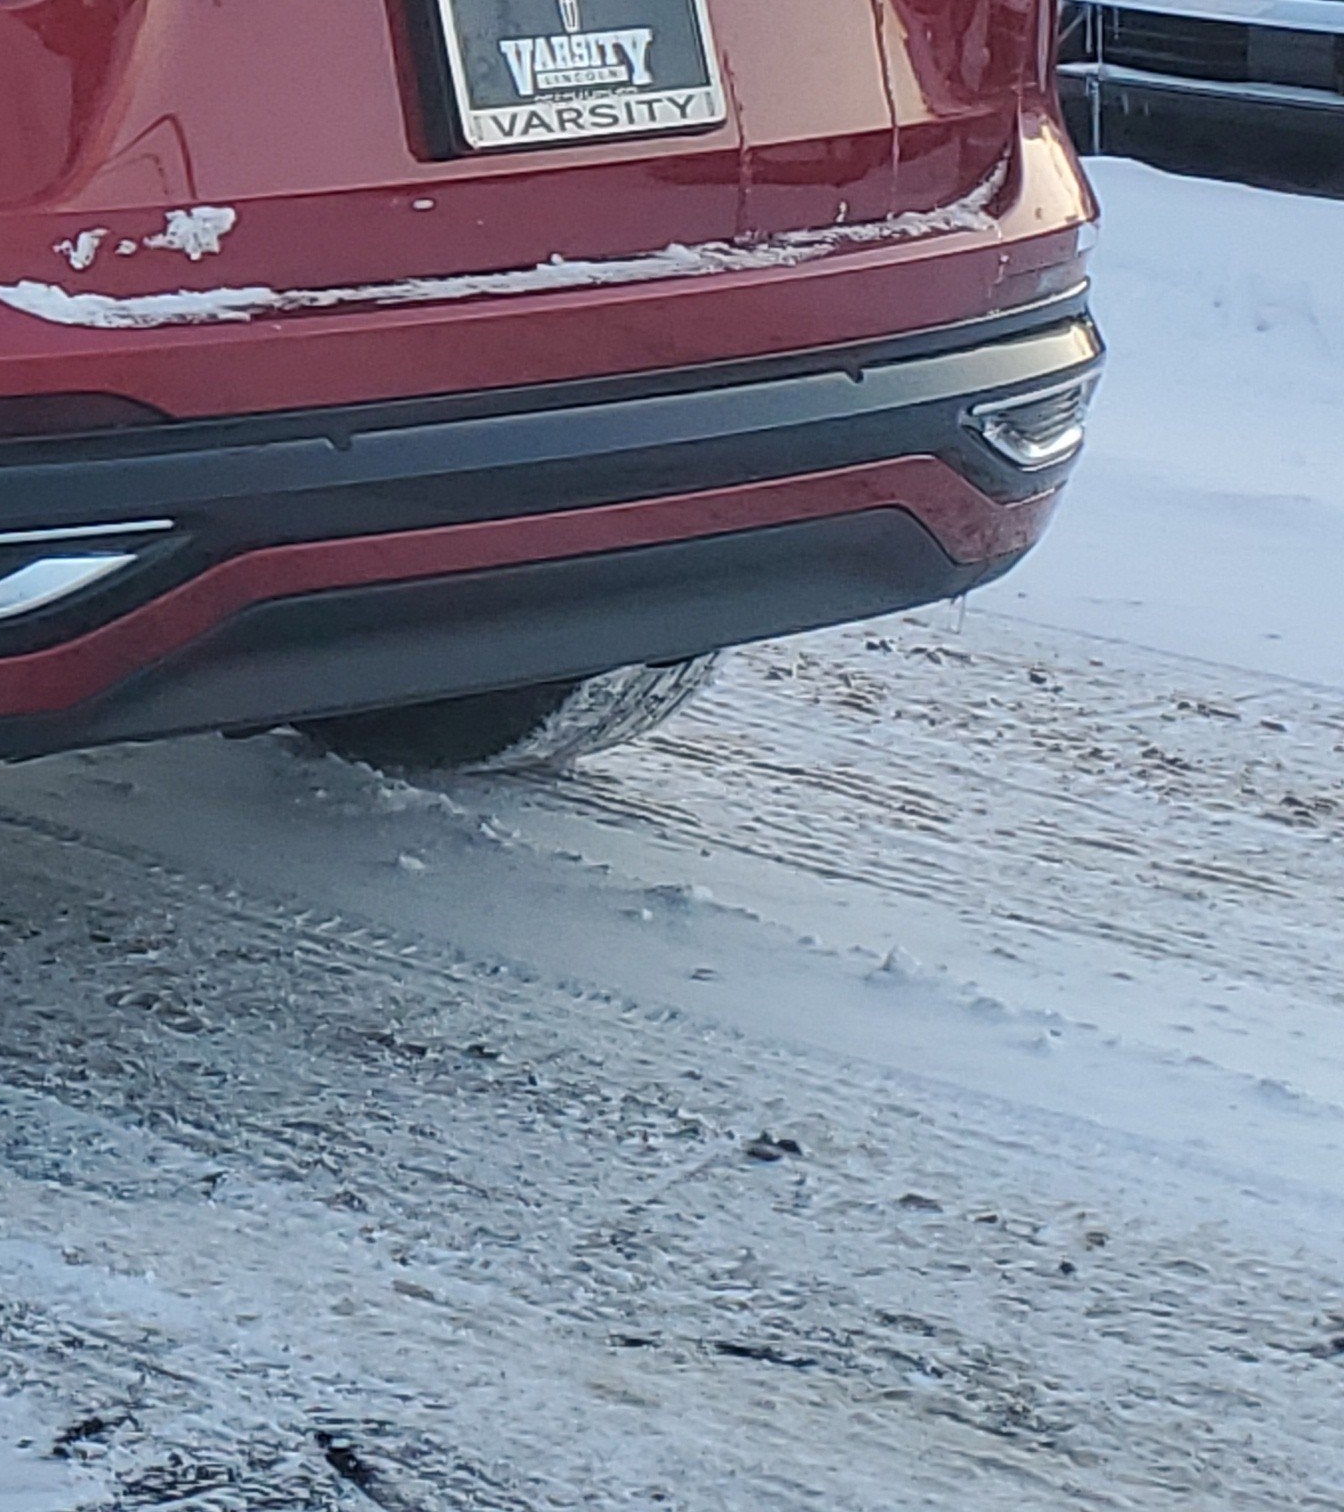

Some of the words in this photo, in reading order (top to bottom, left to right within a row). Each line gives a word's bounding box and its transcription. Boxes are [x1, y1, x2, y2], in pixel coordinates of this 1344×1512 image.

[499, 27, 654, 97] VARSITY
[544, 69, 619, 86] LINCOLN
[490, 93, 696, 138] VARSITY
